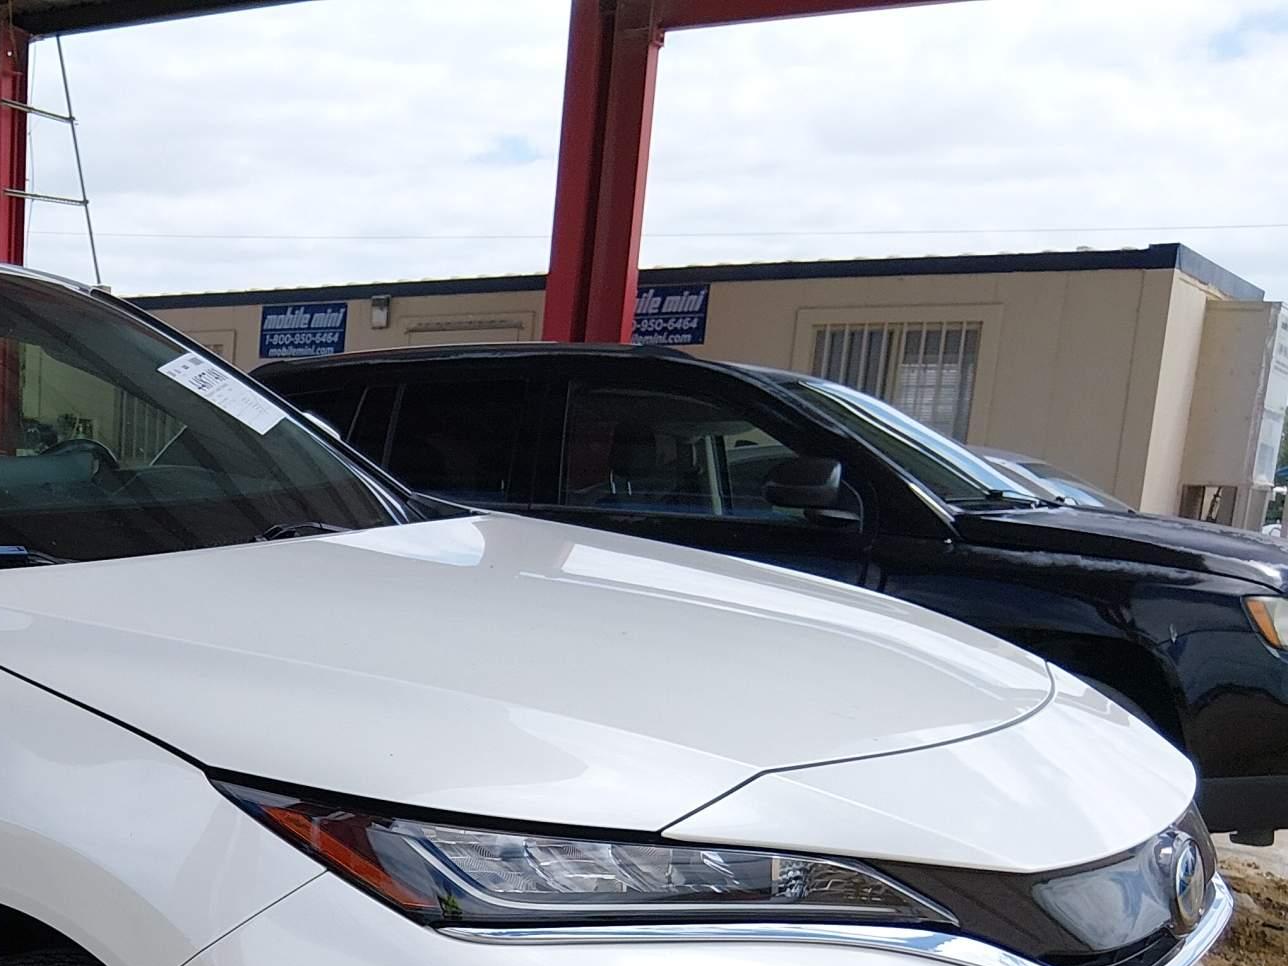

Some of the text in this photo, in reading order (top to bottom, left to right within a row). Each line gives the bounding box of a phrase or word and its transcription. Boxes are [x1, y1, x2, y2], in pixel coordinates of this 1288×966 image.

[661, 290, 706, 312] mini
[263, 307, 345, 329] mobile mini
[265, 332, 339, 345] 1-800-950-6464
